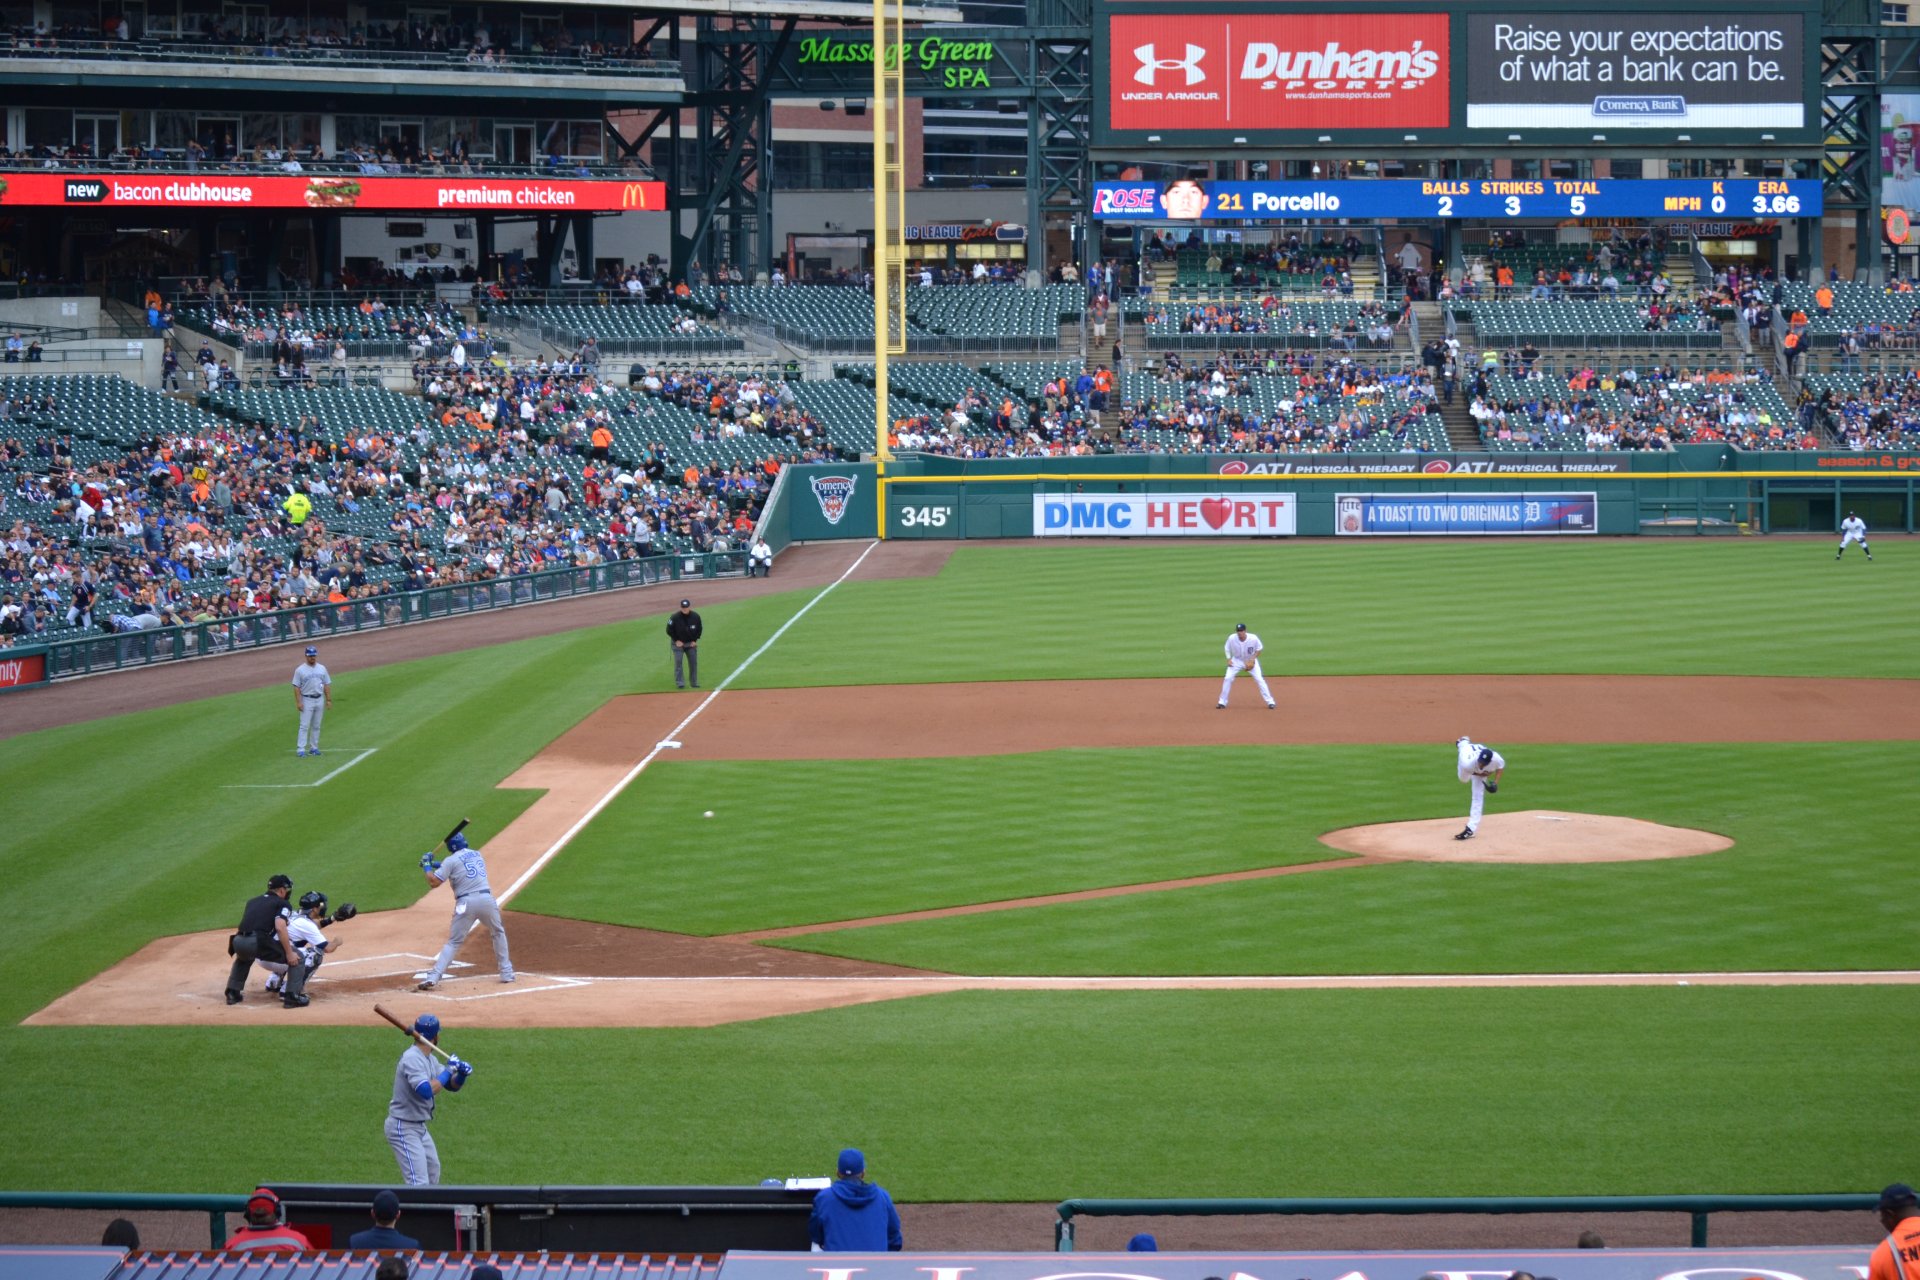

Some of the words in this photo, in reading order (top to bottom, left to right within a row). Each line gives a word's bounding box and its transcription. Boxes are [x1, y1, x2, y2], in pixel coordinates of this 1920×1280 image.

[1494, 24, 1561, 51] Raise
[1569, 30, 1623, 57] your
[1630, 25, 1784, 57] expectations
[918, 36, 993, 70] Green
[1240, 40, 1439, 79] Dunham's
[1500, 55, 1525, 81] of
[1530, 55, 1590, 81] what
[1597, 61, 1613, 81] a
[1623, 55, 1684, 81] bank
[1691, 61, 1737, 81] can
[1748, 55, 1785, 81] be.
[944, 68, 990, 88] SPA
[1260, 80, 1419, 89] SPORTS
[1121, 92, 1163, 100] UNDER
[1165, 92, 1218, 100] ARMOUR
[1285, 91, 1391, 100] www.dunhamssports.com
[1651, 100, 1679, 110] Bank
[67, 184, 99, 197] new
[114, 182, 161, 200] bacon
[165, 182, 252, 202] clubhouse
[1422, 182, 1470, 195] BALLS
[1481, 182, 1544, 195] STRIKES
[1553, 182, 1600, 194] TOTAL
[1712, 181, 1724, 194] K
[1758, 181, 1789, 194] ERA
[438, 186, 512, 207] premium
[516, 187, 574, 204] chicken
[1093, 188, 1156, 213] ROSE
[1217, 193, 1244, 210] 21
[1252, 192, 1340, 211] Porcello
[1664, 197, 1701, 211] MPH
[1711, 195, 1726, 213] 0
[1752, 195, 1801, 213] 3.66
[1437, 196, 1453, 216] 2
[1504, 196, 1521, 216] 3
[1569, 196, 1586, 216] 5
[921, 224, 962, 239] LEAGUE
[1670, 222, 1688, 236] BIG
[1692, 222, 1733, 236] LEAGUE
[1249, 463, 1291, 475] ATI
[1295, 465, 1356, 473] PHYSICAL
[1360, 465, 1415, 473] THERAPY
[1451, 462, 1494, 474] ATI
[1498, 464, 1558, 472] PHYSICAL
[1562, 464, 1617, 472] THERAPY
[1817, 457, 1877, 467] season
[1880, 455, 1894, 467] &
[1044, 502, 1132, 529] DMC
[1368, 506, 1376, 522] A
[1378, 505, 1412, 522] TOAST
[1416, 505, 1430, 522] TO
[1433, 505, 1457, 521] TWO
[1460, 505, 1519, 522] ORIGINALS
[1567, 514, 1584, 525] TIME
